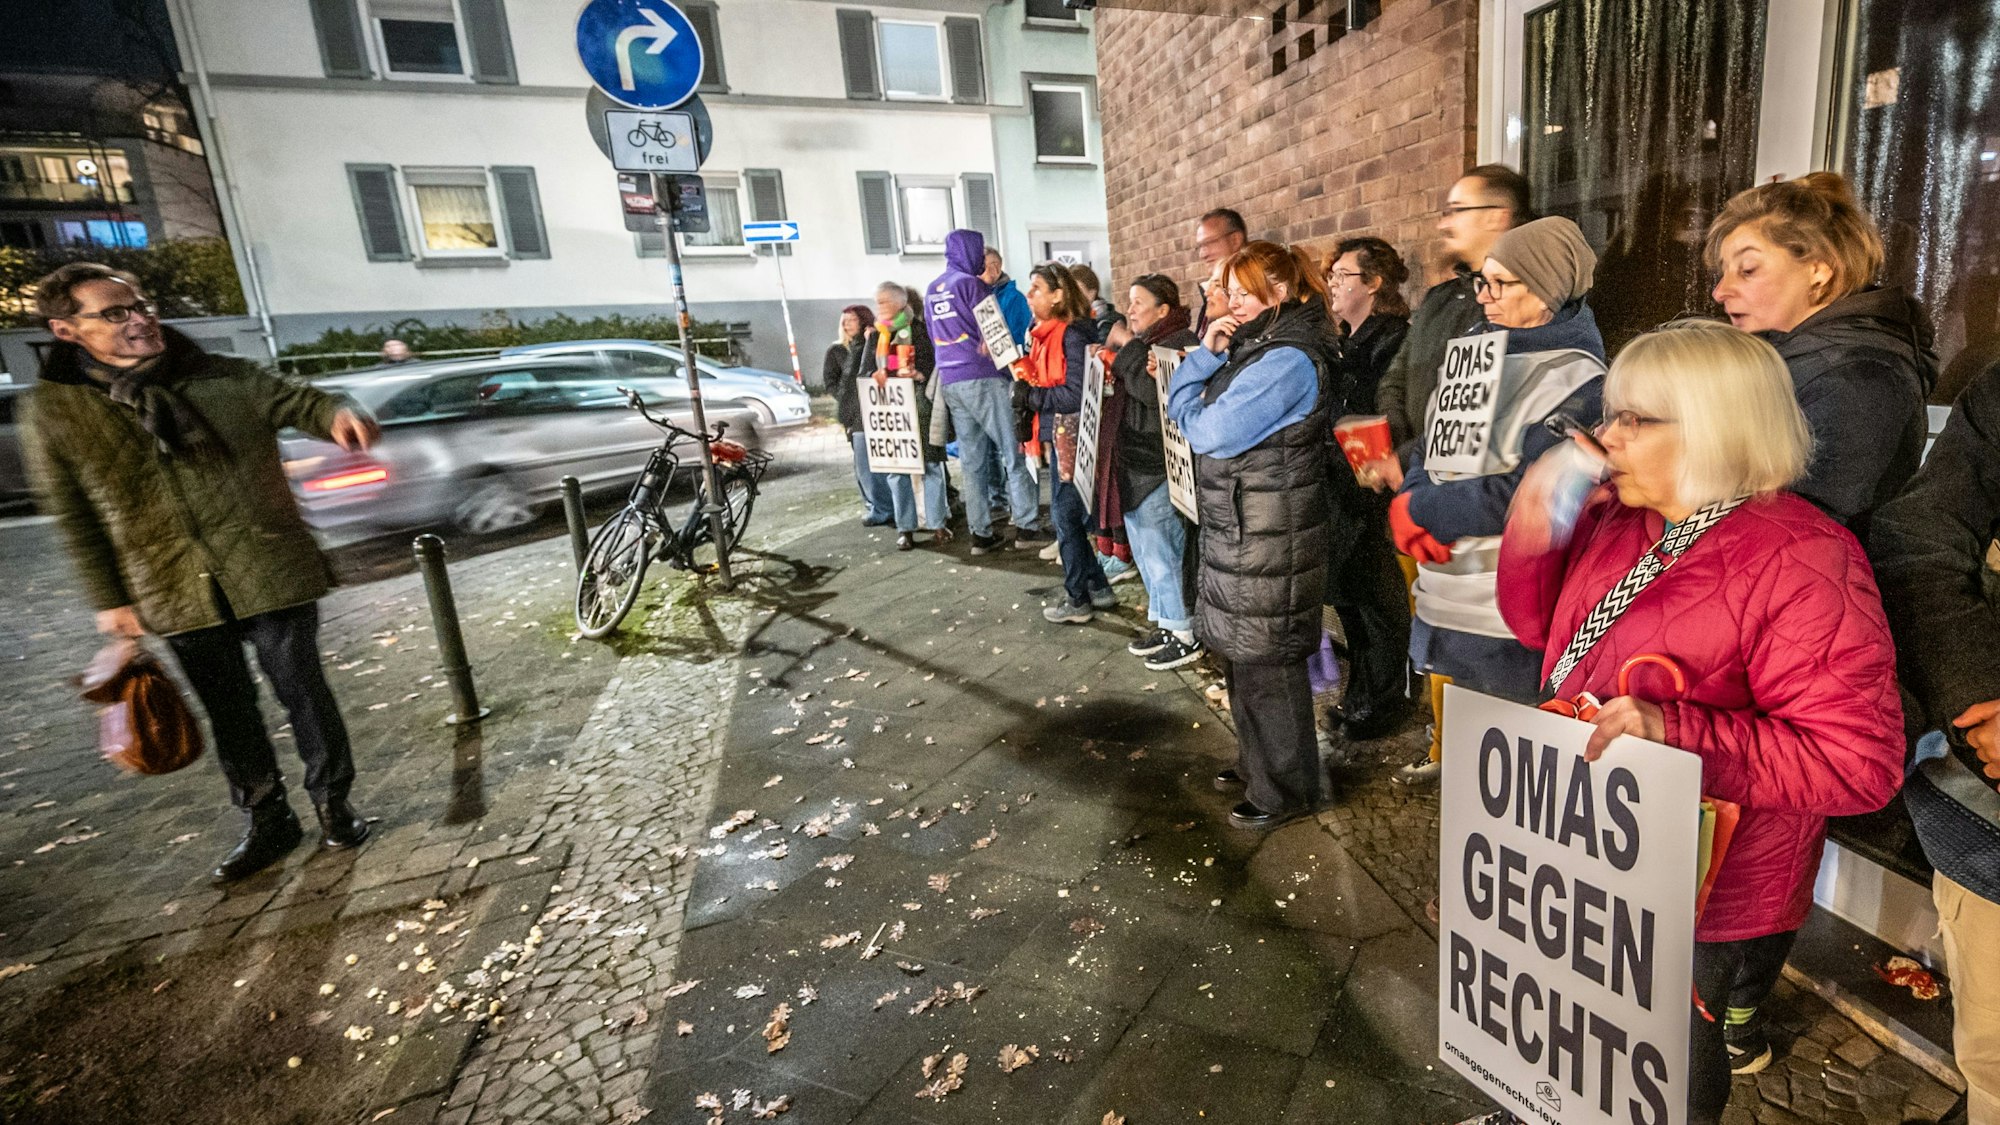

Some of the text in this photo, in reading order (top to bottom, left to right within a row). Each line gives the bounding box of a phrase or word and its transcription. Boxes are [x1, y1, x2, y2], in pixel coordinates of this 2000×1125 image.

[643, 151, 669, 165] frei
[1446, 340, 1495, 380] OMAS
[869, 385, 904, 406] OMAS
[1438, 382, 1490, 412] GEGEN
[869, 411, 912, 432] GEGEN
[1429, 418, 1486, 458] RECHTS
[869, 438, 919, 459] RECHTS
[1166, 447, 1193, 496] RECHTS
[1479, 727, 1640, 871] OMAS
[1463, 832, 1655, 1013] GEGEN
[1450, 930, 1669, 1125] RECHTS
[1445, 1041, 1562, 1125] omasgegenrechts-lev
